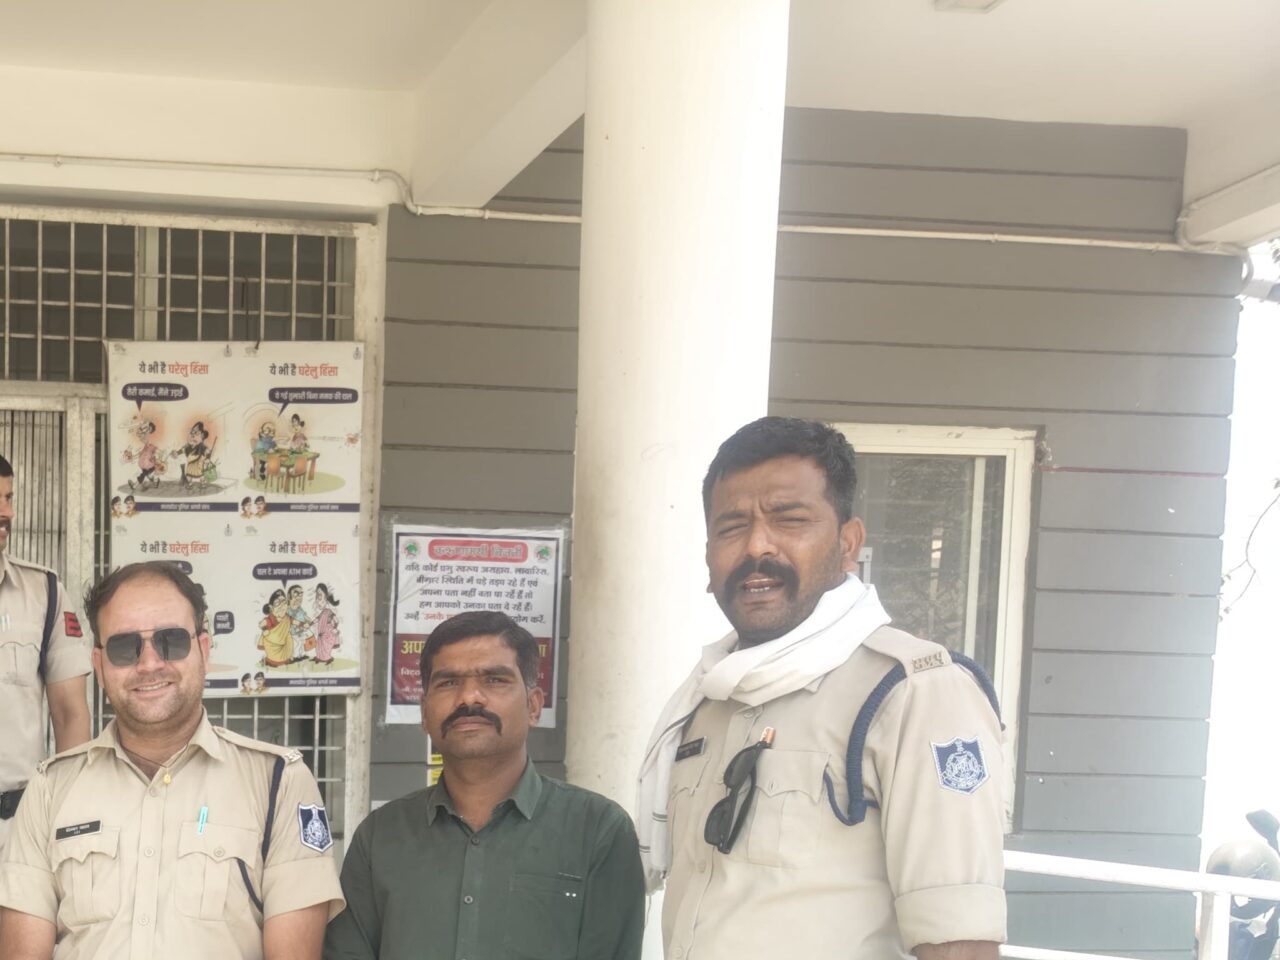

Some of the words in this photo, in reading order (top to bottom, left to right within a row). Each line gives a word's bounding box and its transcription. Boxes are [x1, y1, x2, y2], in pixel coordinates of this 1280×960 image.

[139, 361, 146, 373] ये
[148, 361, 158, 374] भी
[160, 361, 166, 374] है
[190, 362, 208, 374] हिंसा
[269, 363, 276, 375] ये
[279, 363, 288, 376] भी
[290, 363, 296, 376] है
[320, 364, 338, 376] हिंसा
[140, 542, 147, 552] ये
[149, 542, 160, 553] भी
[162, 542, 168, 553] है
[190, 541, 209, 553] हिंसा
[270, 542, 276, 552] ये
[278, 542, 288, 553] भी
[290, 542, 296, 553] है
[319, 541, 337, 553] हिंसा
[434, 600, 461, 609] आपको
